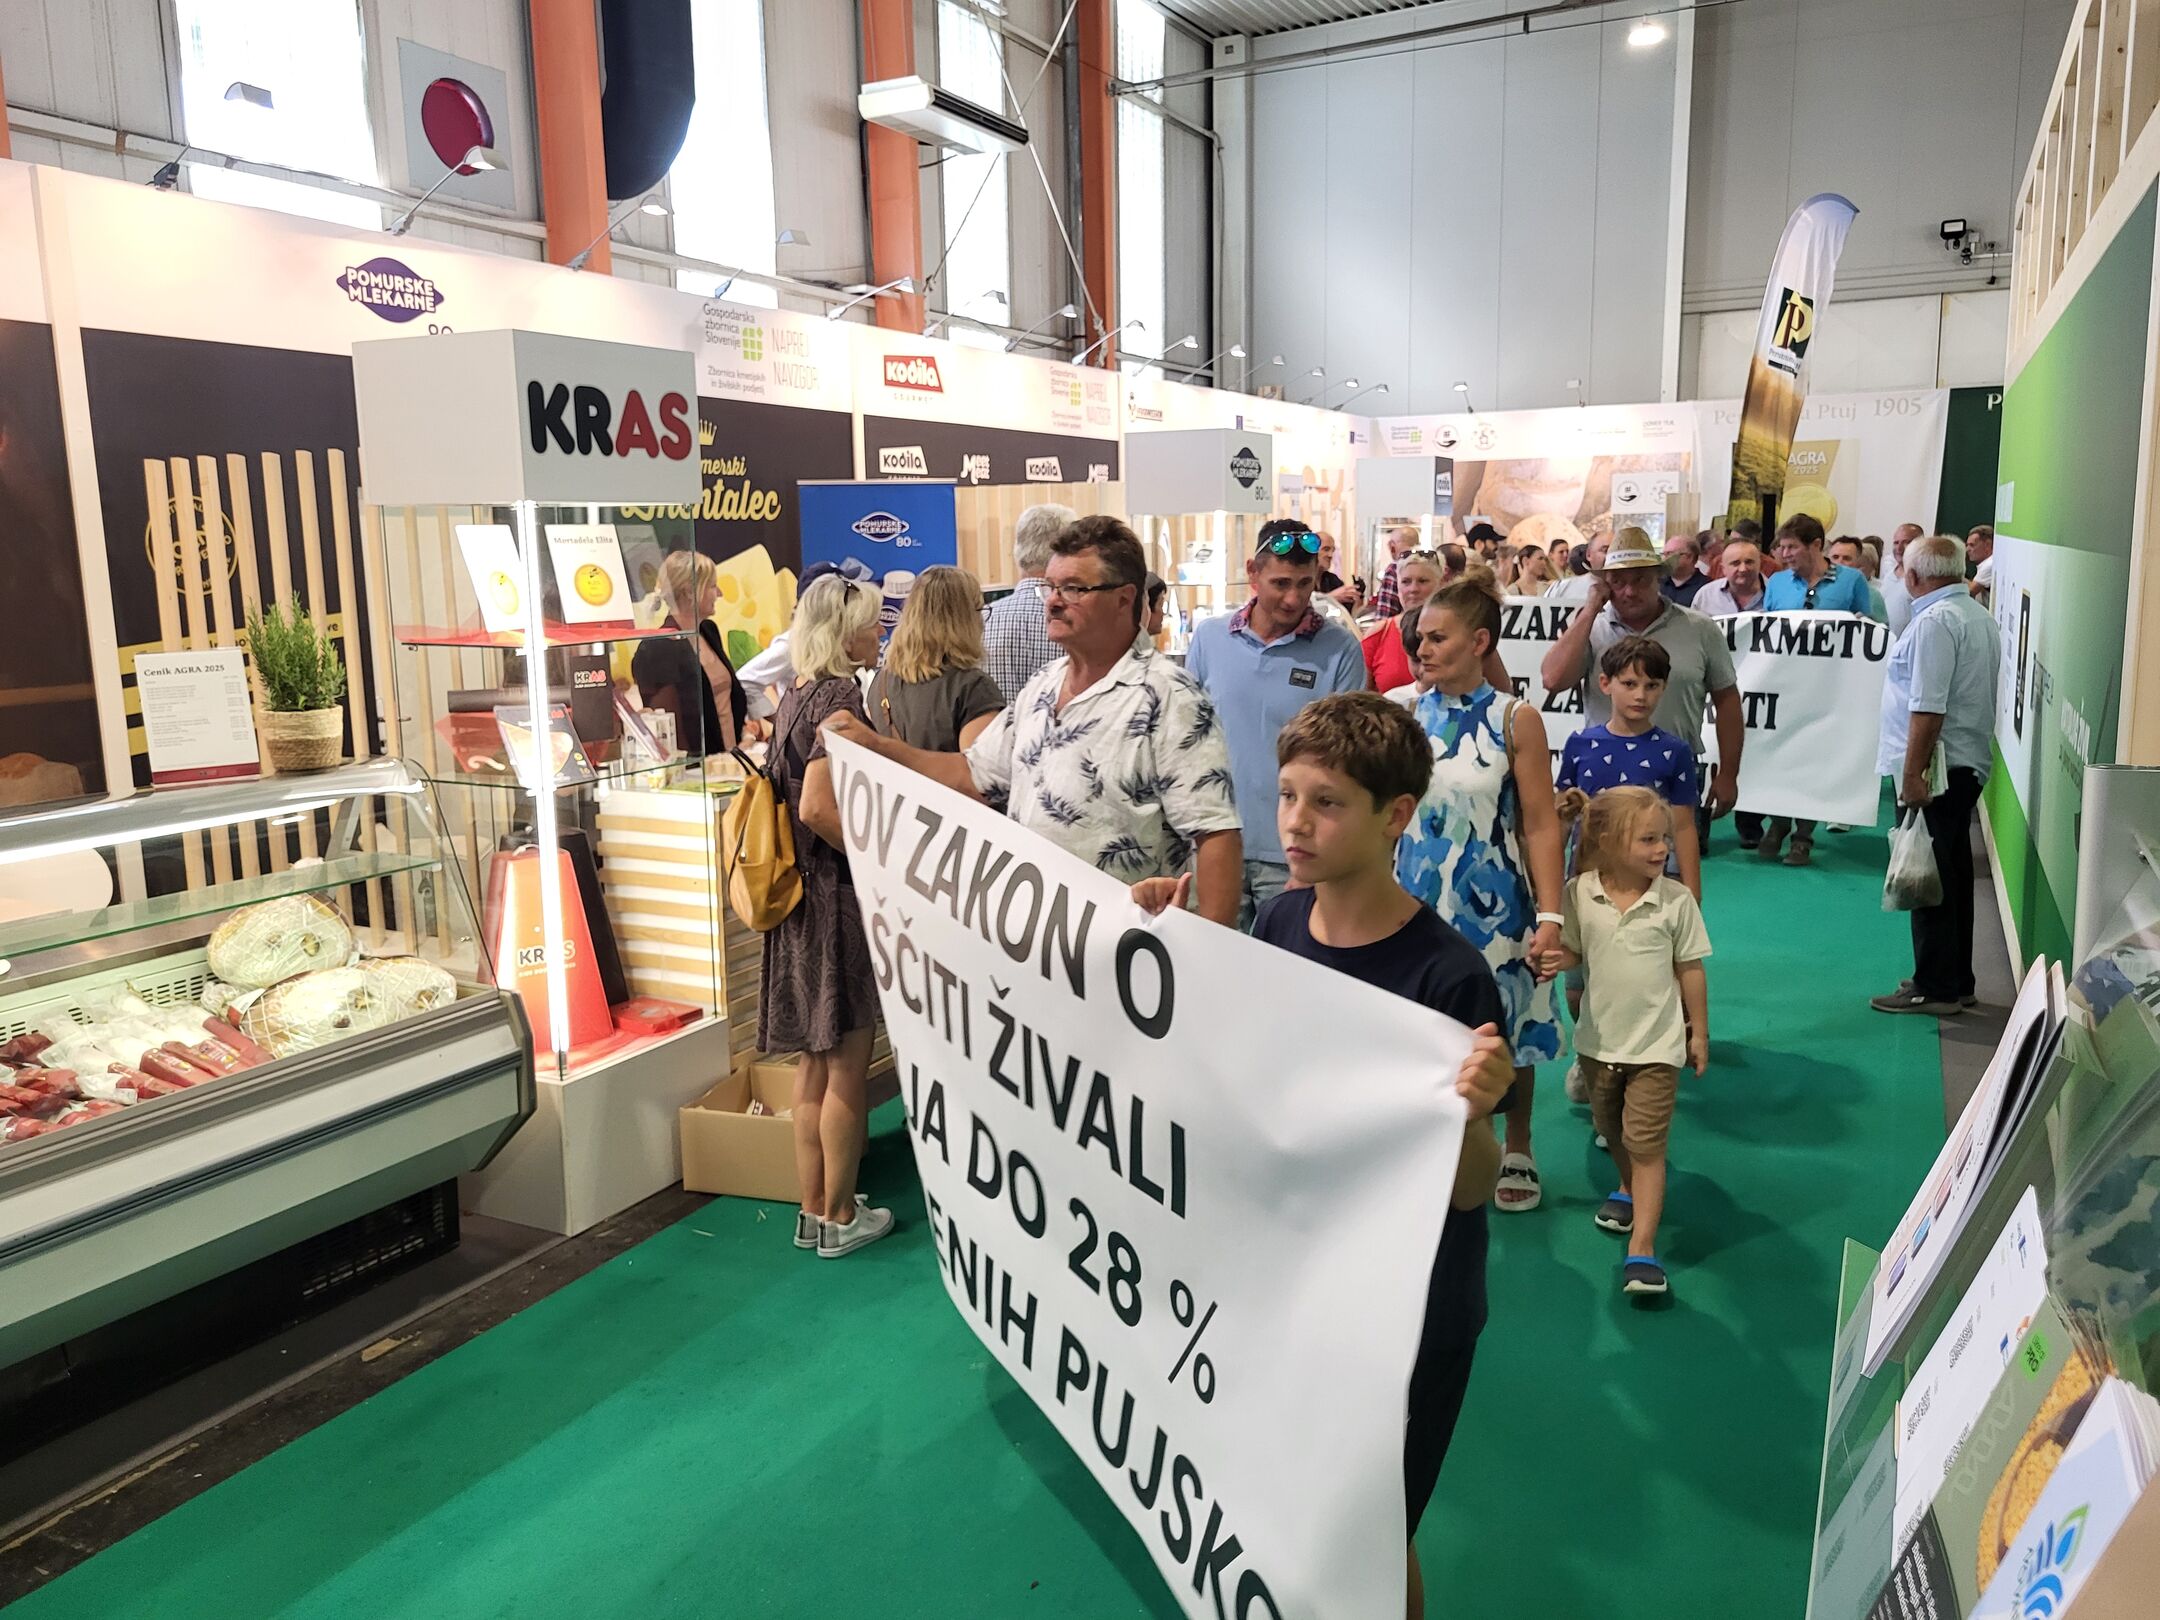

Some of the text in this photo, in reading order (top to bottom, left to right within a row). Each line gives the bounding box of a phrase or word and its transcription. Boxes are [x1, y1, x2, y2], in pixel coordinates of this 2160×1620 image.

[346, 266, 434, 297] POMURSKE
[348, 284, 436, 312] MLEKARNE
[703, 303, 756, 324] Gospodarska
[705, 319, 740, 334] zbornica
[705, 331, 741, 350] Slovenije
[528, 381, 692, 461] KRAS
[1818, 403, 1857, 422] Ptuj
[1874, 397, 1922, 418] 1905
[1788, 451, 1827, 466] AGRA
[1793, 466, 1819, 475] 2025
[595, 536, 614, 544] Elita
[896, 536, 912, 548] 80
[1750, 615, 1891, 662] KMETU
[144, 663, 225, 676] Cenik AGRA 2025
[575, 669, 607, 684] KRAS
[905, 806, 1096, 999] ZAKON
[1115, 928, 1175, 1039] O
[519, 940, 576, 966] KRS
[988, 973, 1186, 1219] ŽIVALI
[967, 1111, 1047, 1239] DO
[1068, 1198, 1142, 1327] 28
[1168, 1280, 1218, 1404] %
